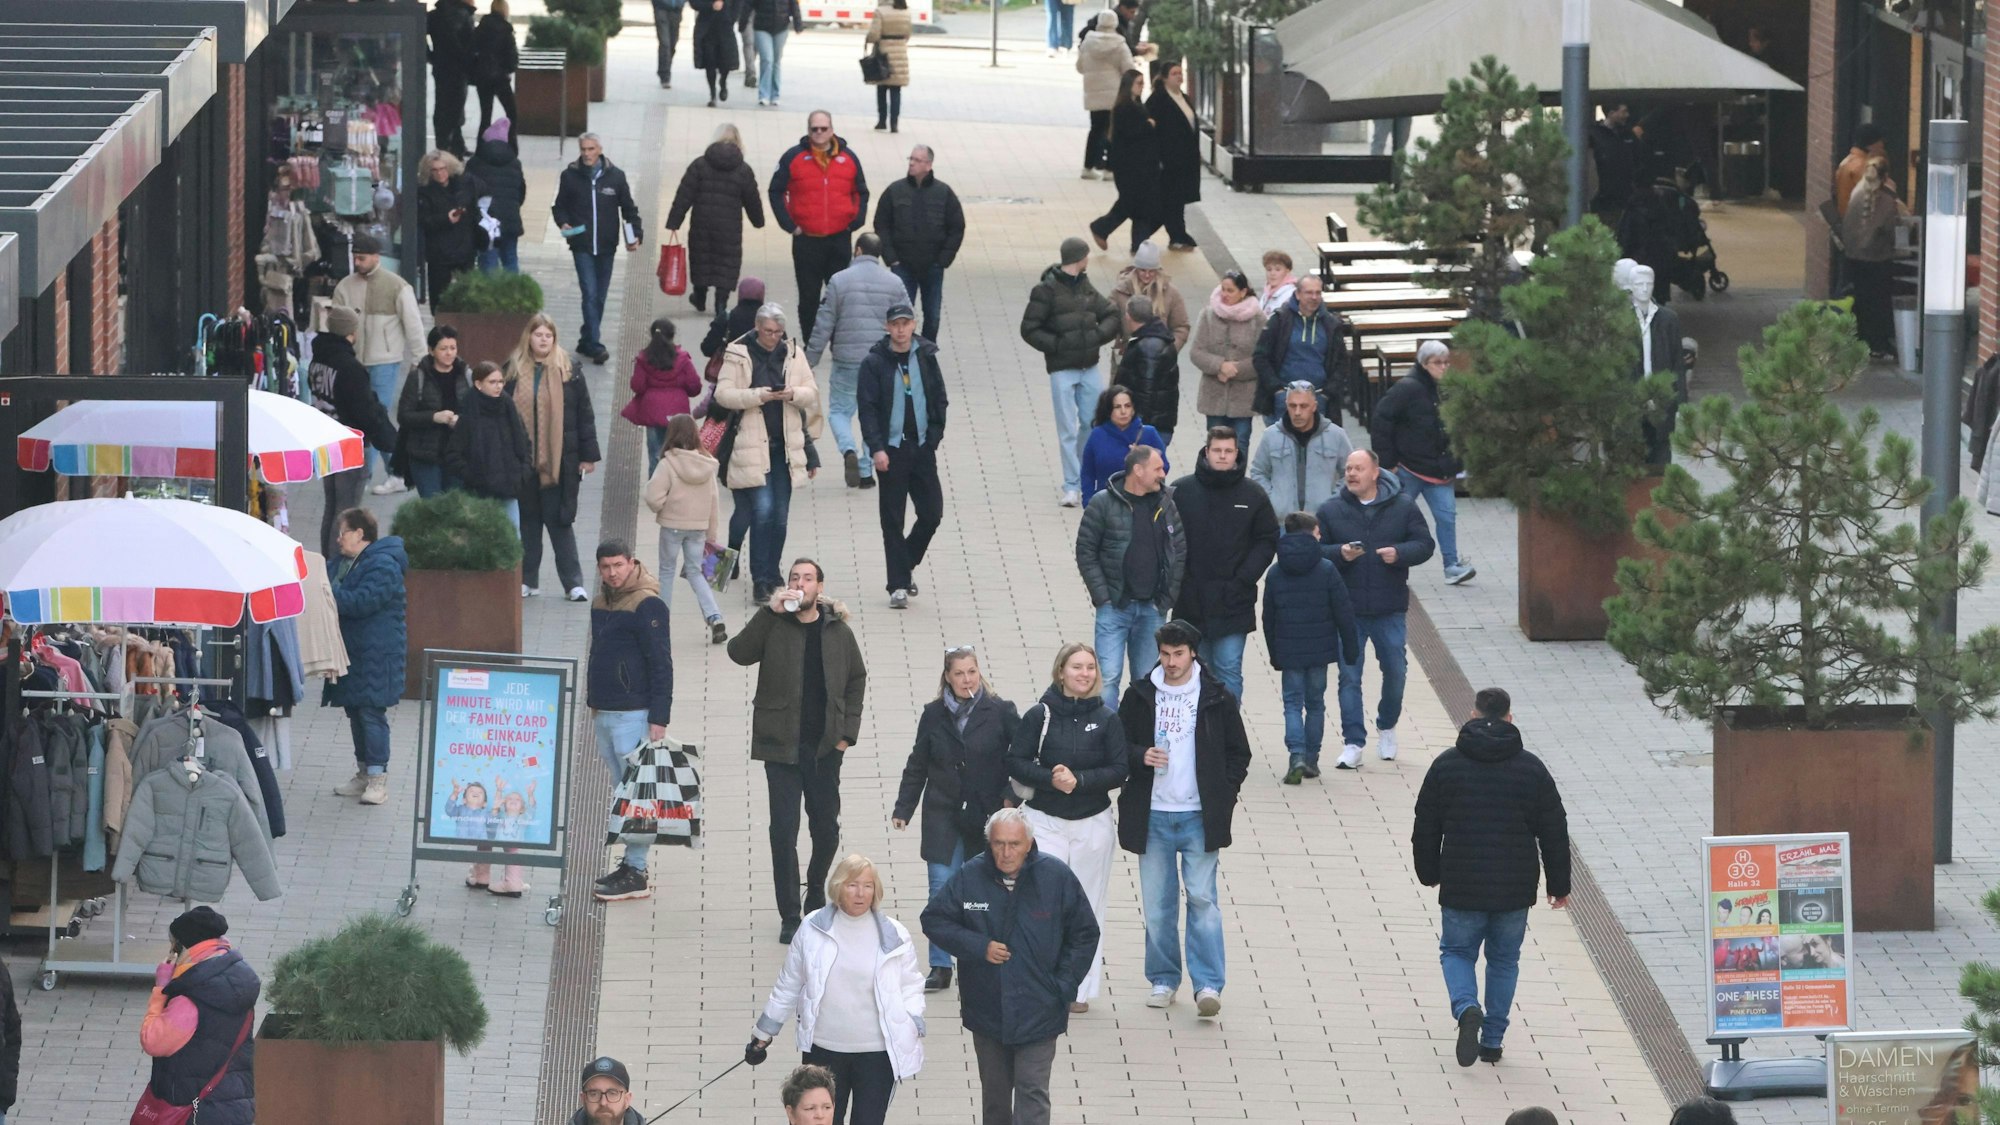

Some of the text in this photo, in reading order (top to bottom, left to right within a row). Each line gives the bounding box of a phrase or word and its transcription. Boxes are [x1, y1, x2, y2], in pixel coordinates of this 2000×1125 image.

[503, 682, 530, 695] JEDE
[446, 695, 545, 712] MINUTE WIRD MIT
[446, 710, 548, 728] DER FAMILY CARD
[466, 728, 539, 743] EIN EINKAUF
[449, 742, 516, 757] GEWONNEN
[1779, 848, 1816, 862] ERZÄHL
[1727, 880, 1748, 888] Halle
[1716, 991, 1740, 1002] ONE
[1744, 989, 1780, 1000] THESE
[1746, 1007, 1767, 1015] FLOYD
[1839, 1046, 1934, 1068] DAMEN
[1839, 1069, 1917, 1084] Haarschnitt
[1839, 1083, 1915, 1098] & Waschen
[1846, 1102, 1909, 1114] ohne Termin
